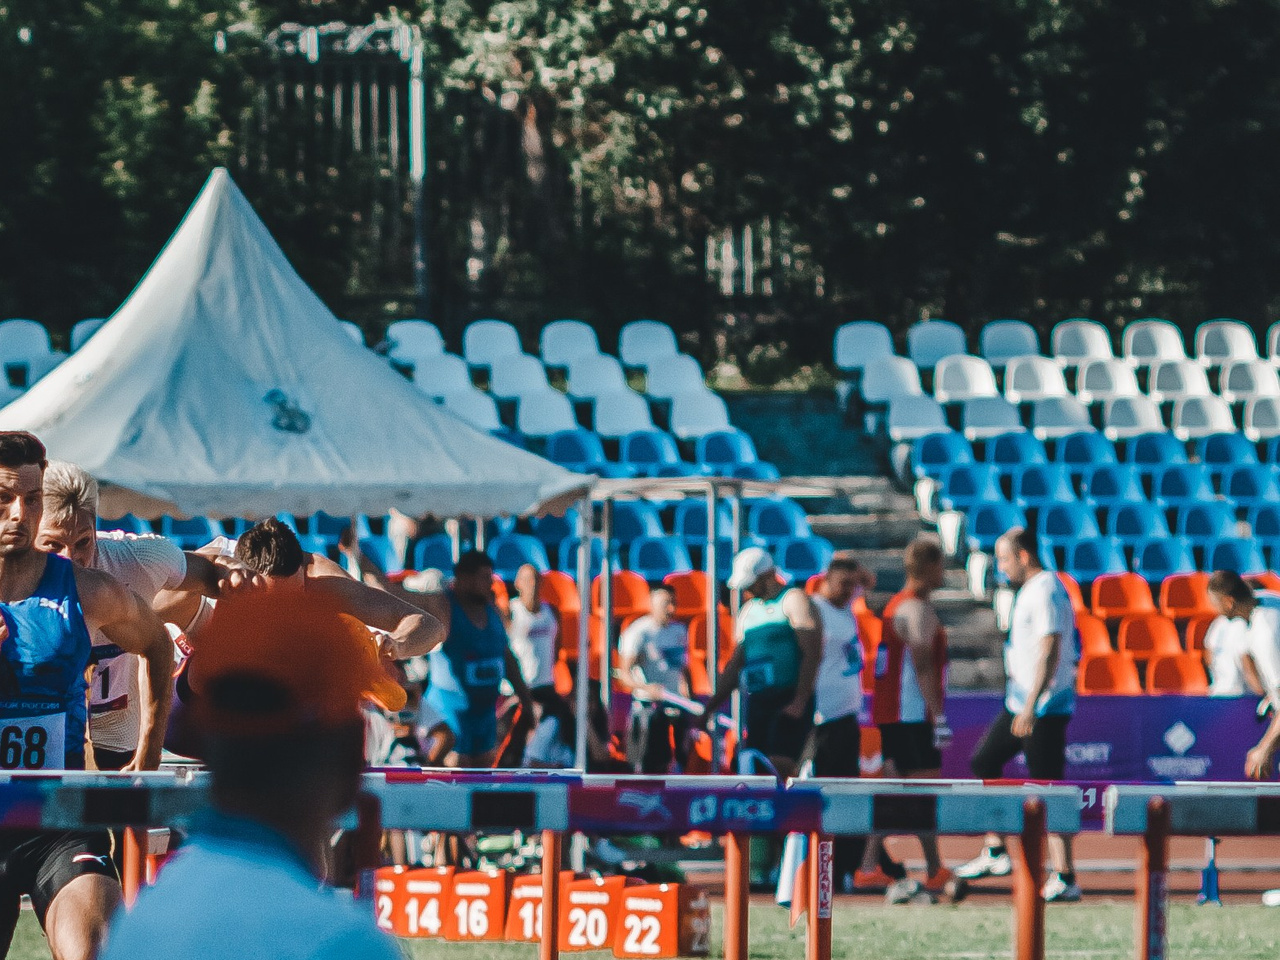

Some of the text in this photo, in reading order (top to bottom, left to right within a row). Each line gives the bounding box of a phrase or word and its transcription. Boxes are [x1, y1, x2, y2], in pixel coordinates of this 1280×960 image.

[404, 896, 442, 935] 14
[454, 898, 489, 937] 16
[568, 907, 608, 947] 20
[623, 913, 661, 954] 22
